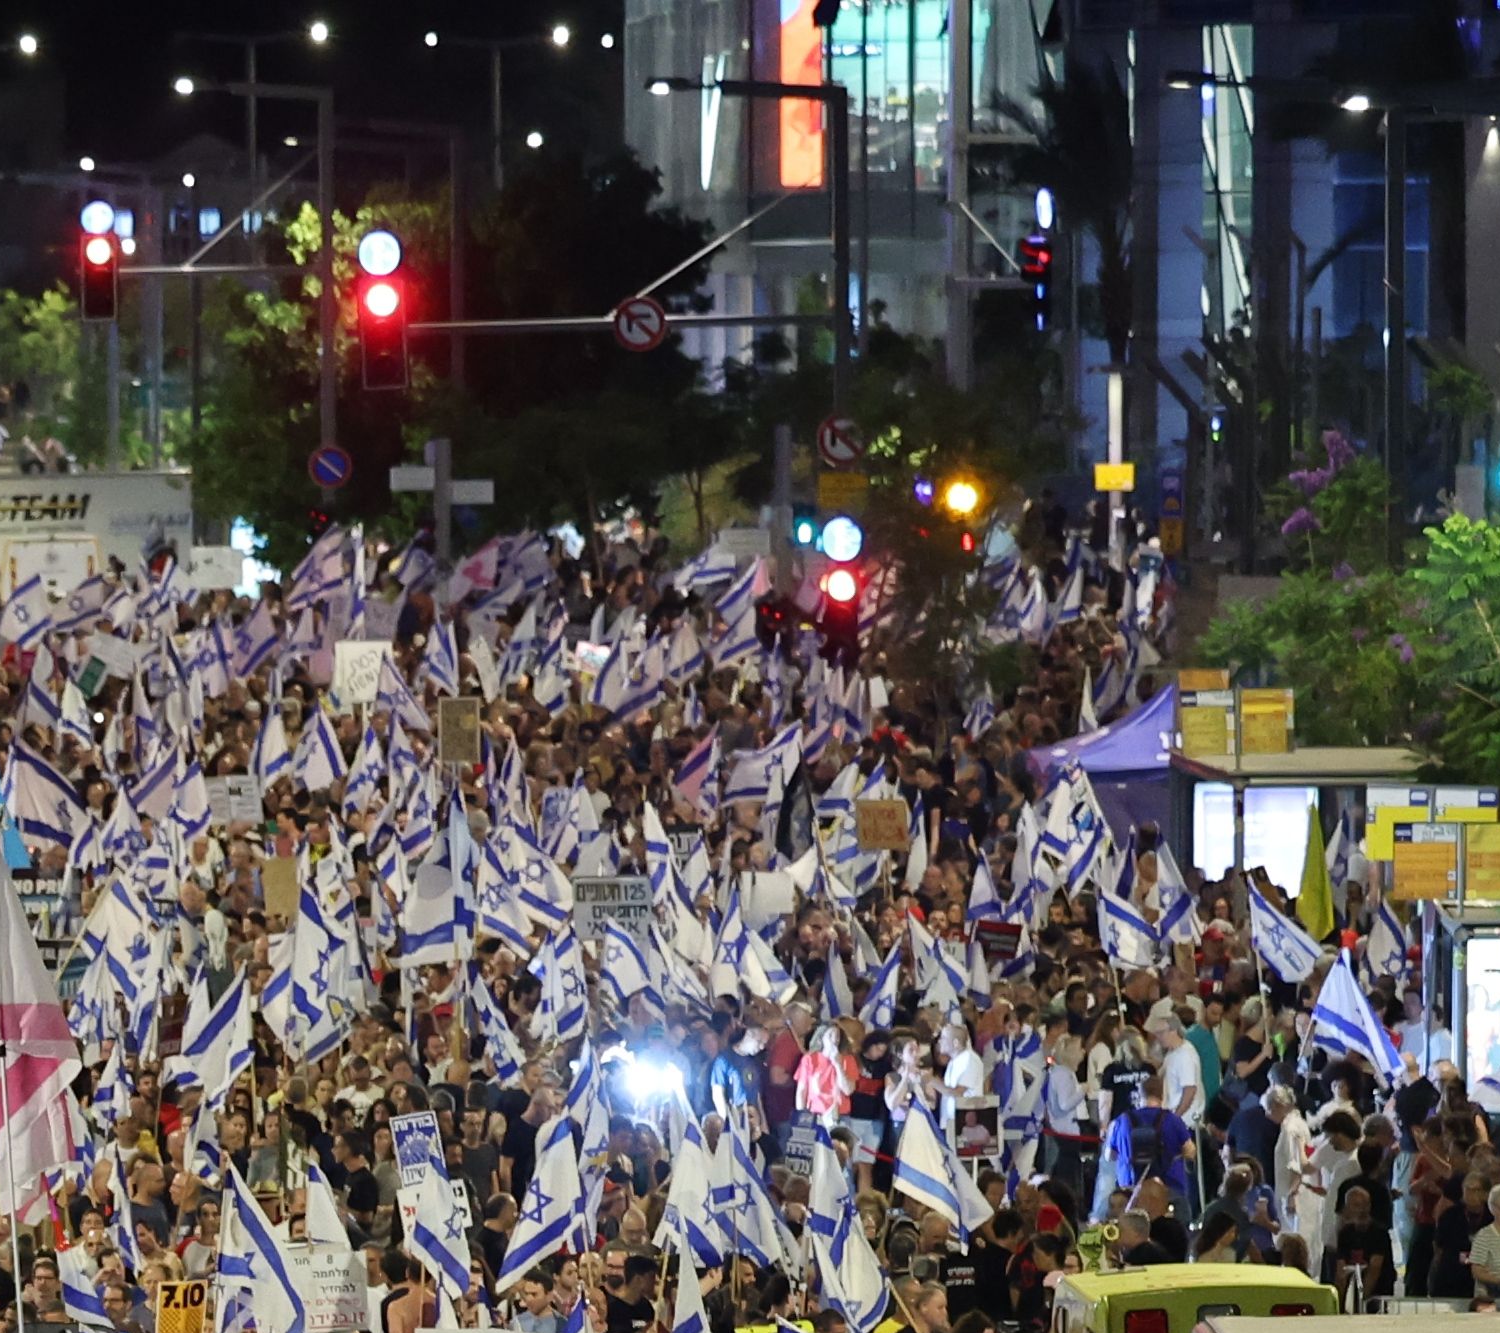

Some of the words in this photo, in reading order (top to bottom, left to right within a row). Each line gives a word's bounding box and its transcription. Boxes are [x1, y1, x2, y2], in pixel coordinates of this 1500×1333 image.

[623, 883, 646, 901] 125
[312, 1267, 350, 1281] מלחמה
[162, 1284, 204, 1308] 7.10
